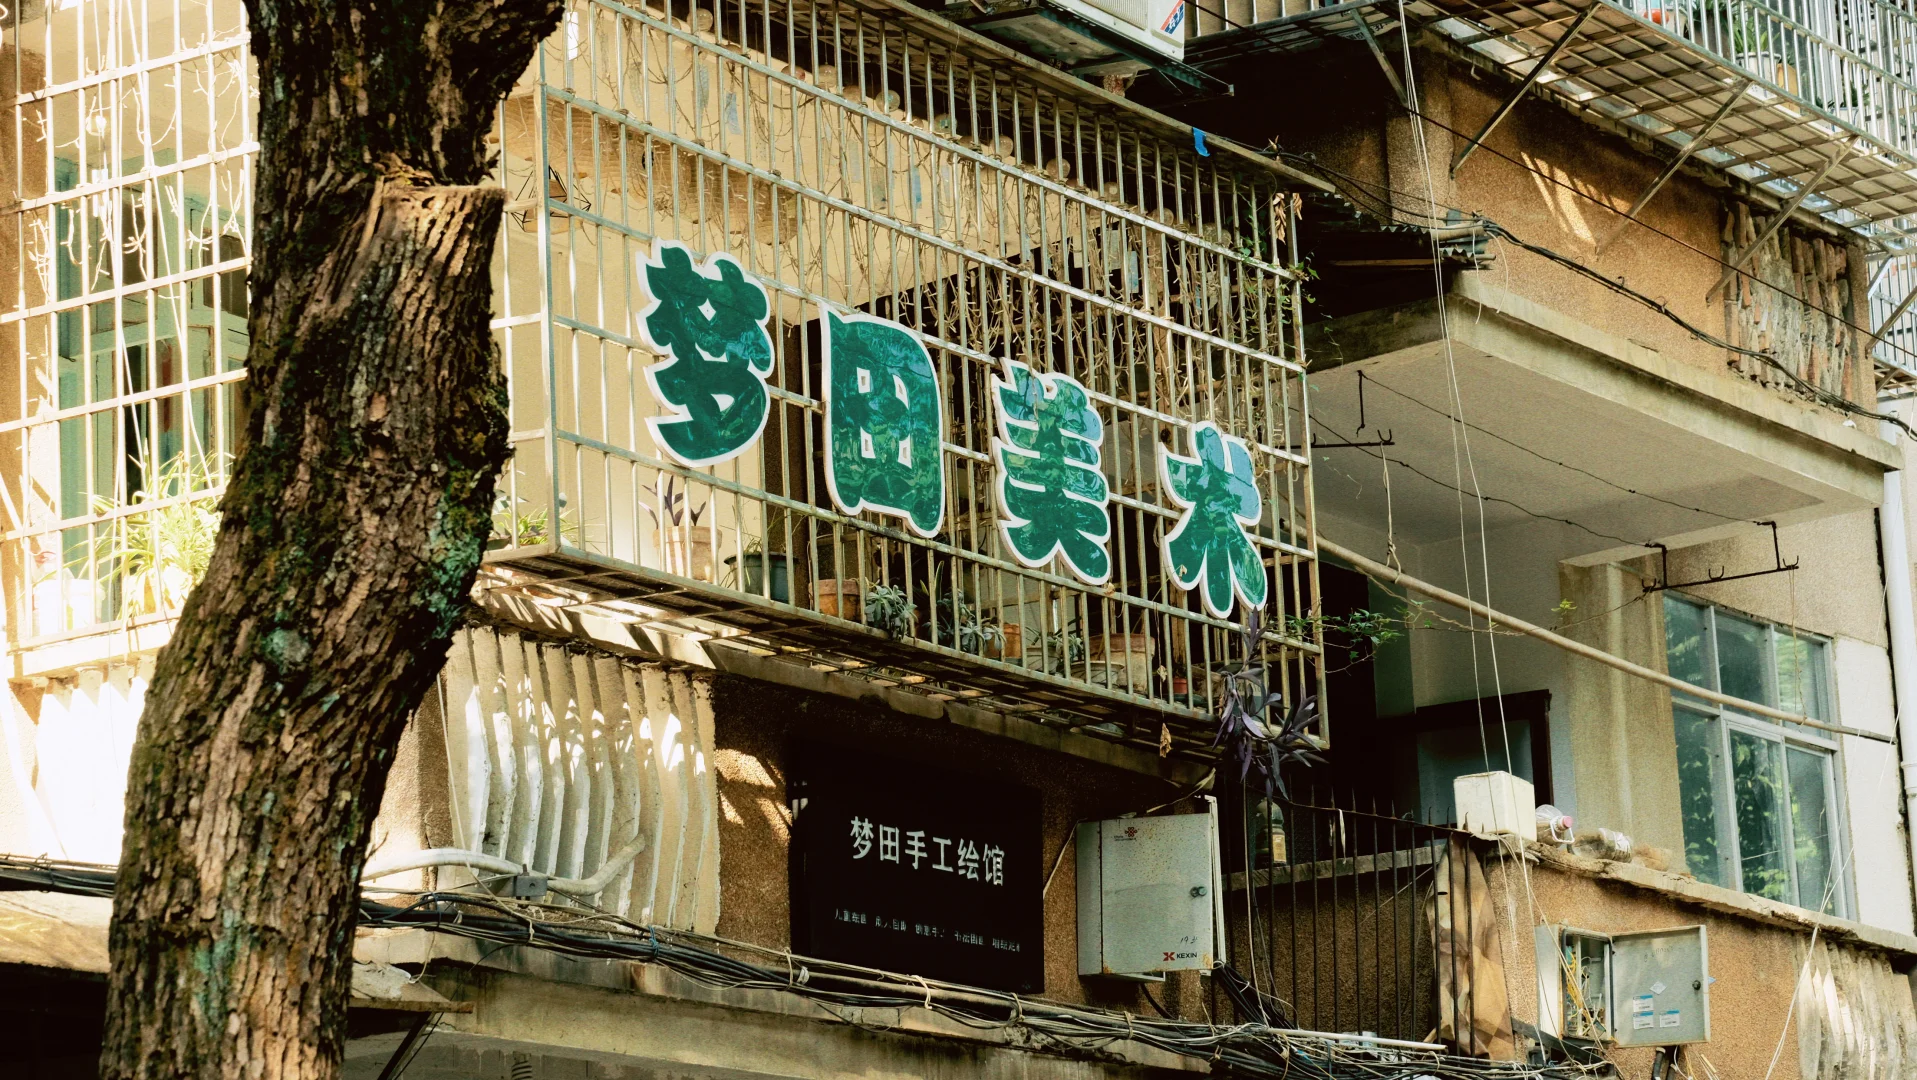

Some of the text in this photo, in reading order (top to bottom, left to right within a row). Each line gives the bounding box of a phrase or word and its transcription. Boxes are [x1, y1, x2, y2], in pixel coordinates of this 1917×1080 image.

[637, 238, 1268, 618] 梦田美术
[849, 815, 1005, 887] 梦田手工绘馆
